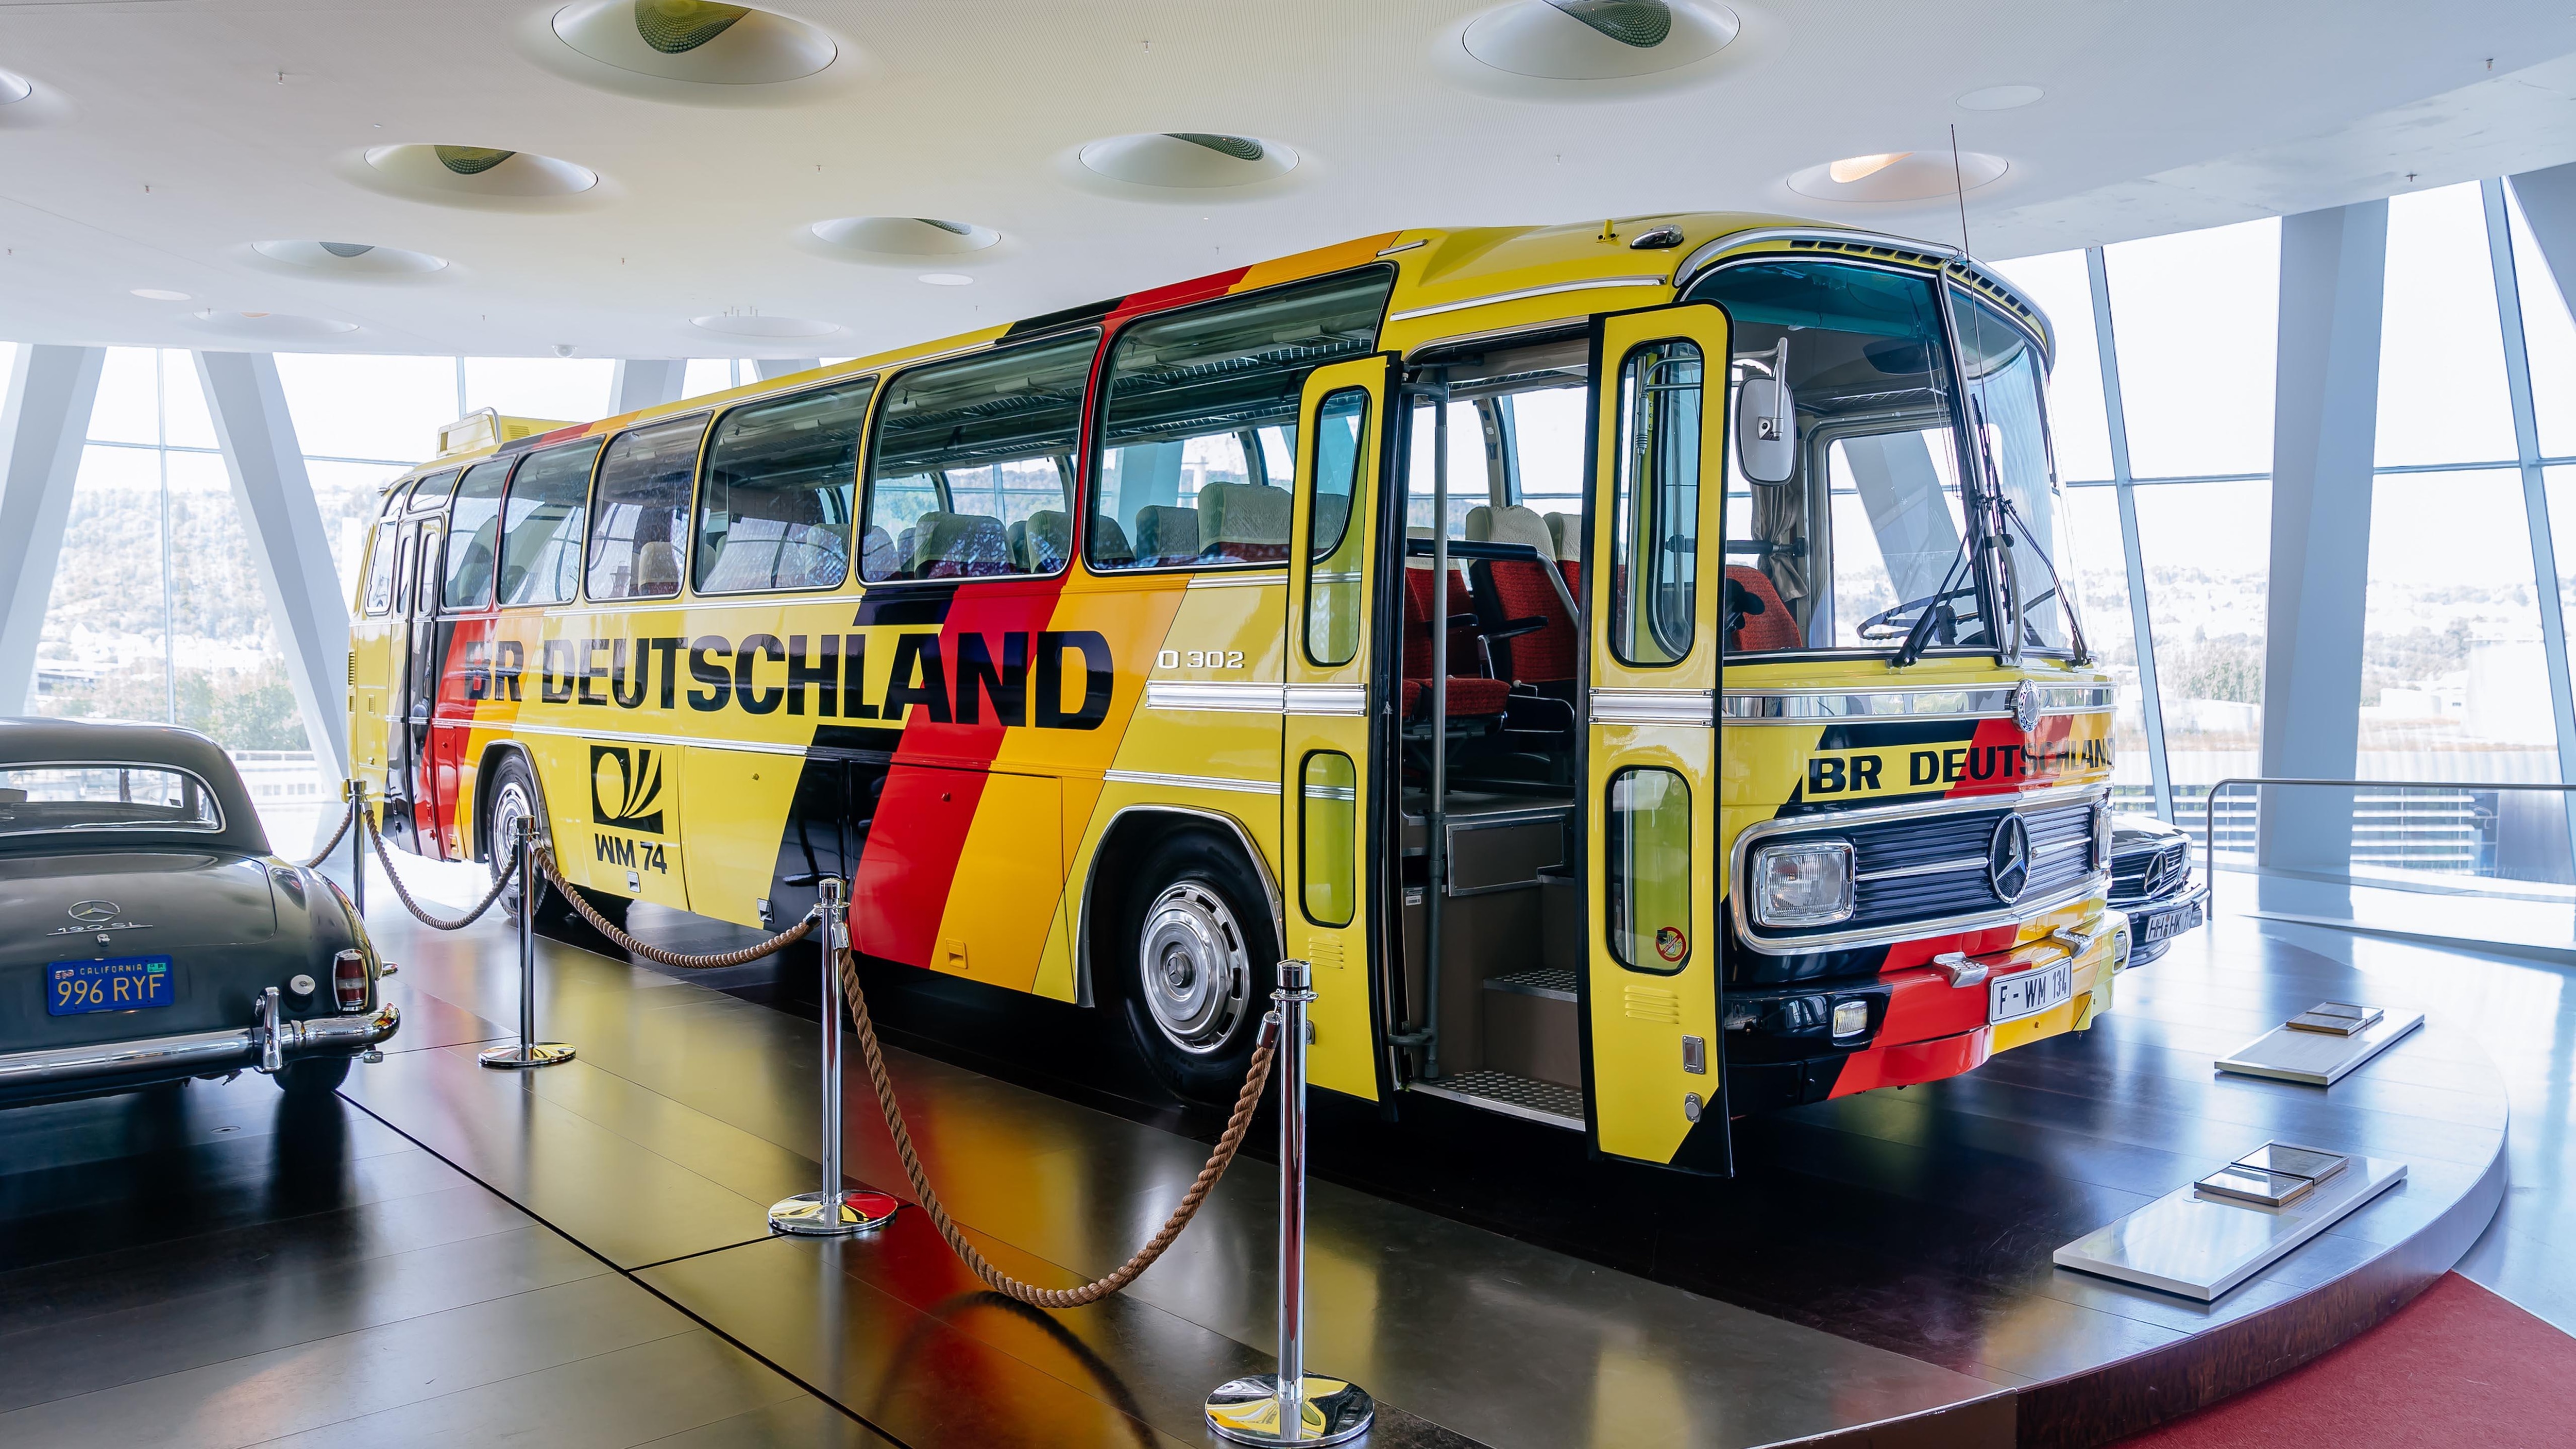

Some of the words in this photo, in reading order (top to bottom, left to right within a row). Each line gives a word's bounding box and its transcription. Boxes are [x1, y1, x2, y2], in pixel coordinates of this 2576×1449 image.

[1187, 651, 1245, 669] 302
[465, 640, 524, 702] BR
[541, 630, 1114, 731] DEUTSCHLAND
[1808, 755, 1883, 794] BR
[595, 833, 636, 868] WM
[640, 841, 668, 875] 74
[80, 964, 142, 975] CALIFORNIA
[2053, 967, 2066, 999] 134
[58, 979, 104, 1007] 996
[113, 974, 164, 1001] RYF
